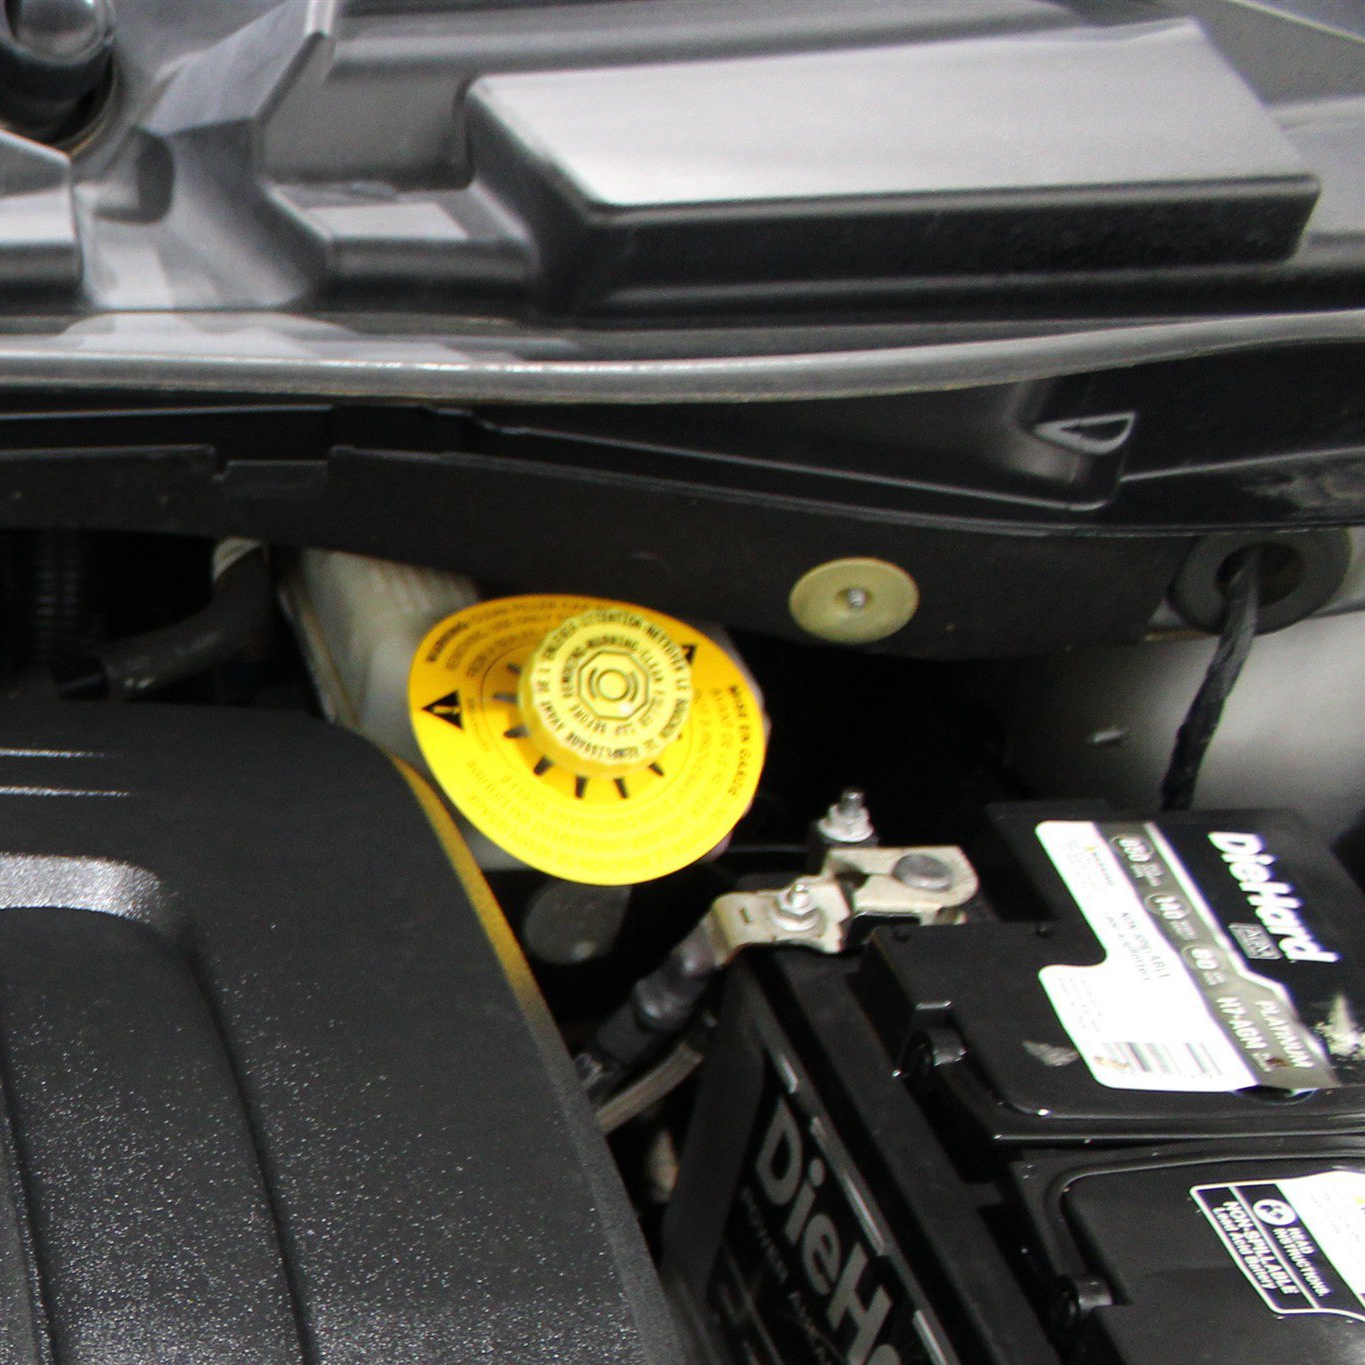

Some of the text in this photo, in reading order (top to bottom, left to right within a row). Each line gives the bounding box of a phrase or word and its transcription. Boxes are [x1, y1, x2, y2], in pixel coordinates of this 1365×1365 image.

[1207, 831, 1341, 963] DieHard
[1217, 997, 1268, 1050] H7-AGM
[1255, 1000, 1315, 1068] PLATINUM
[1223, 1200, 1300, 1295] NON-SPILLABLE
